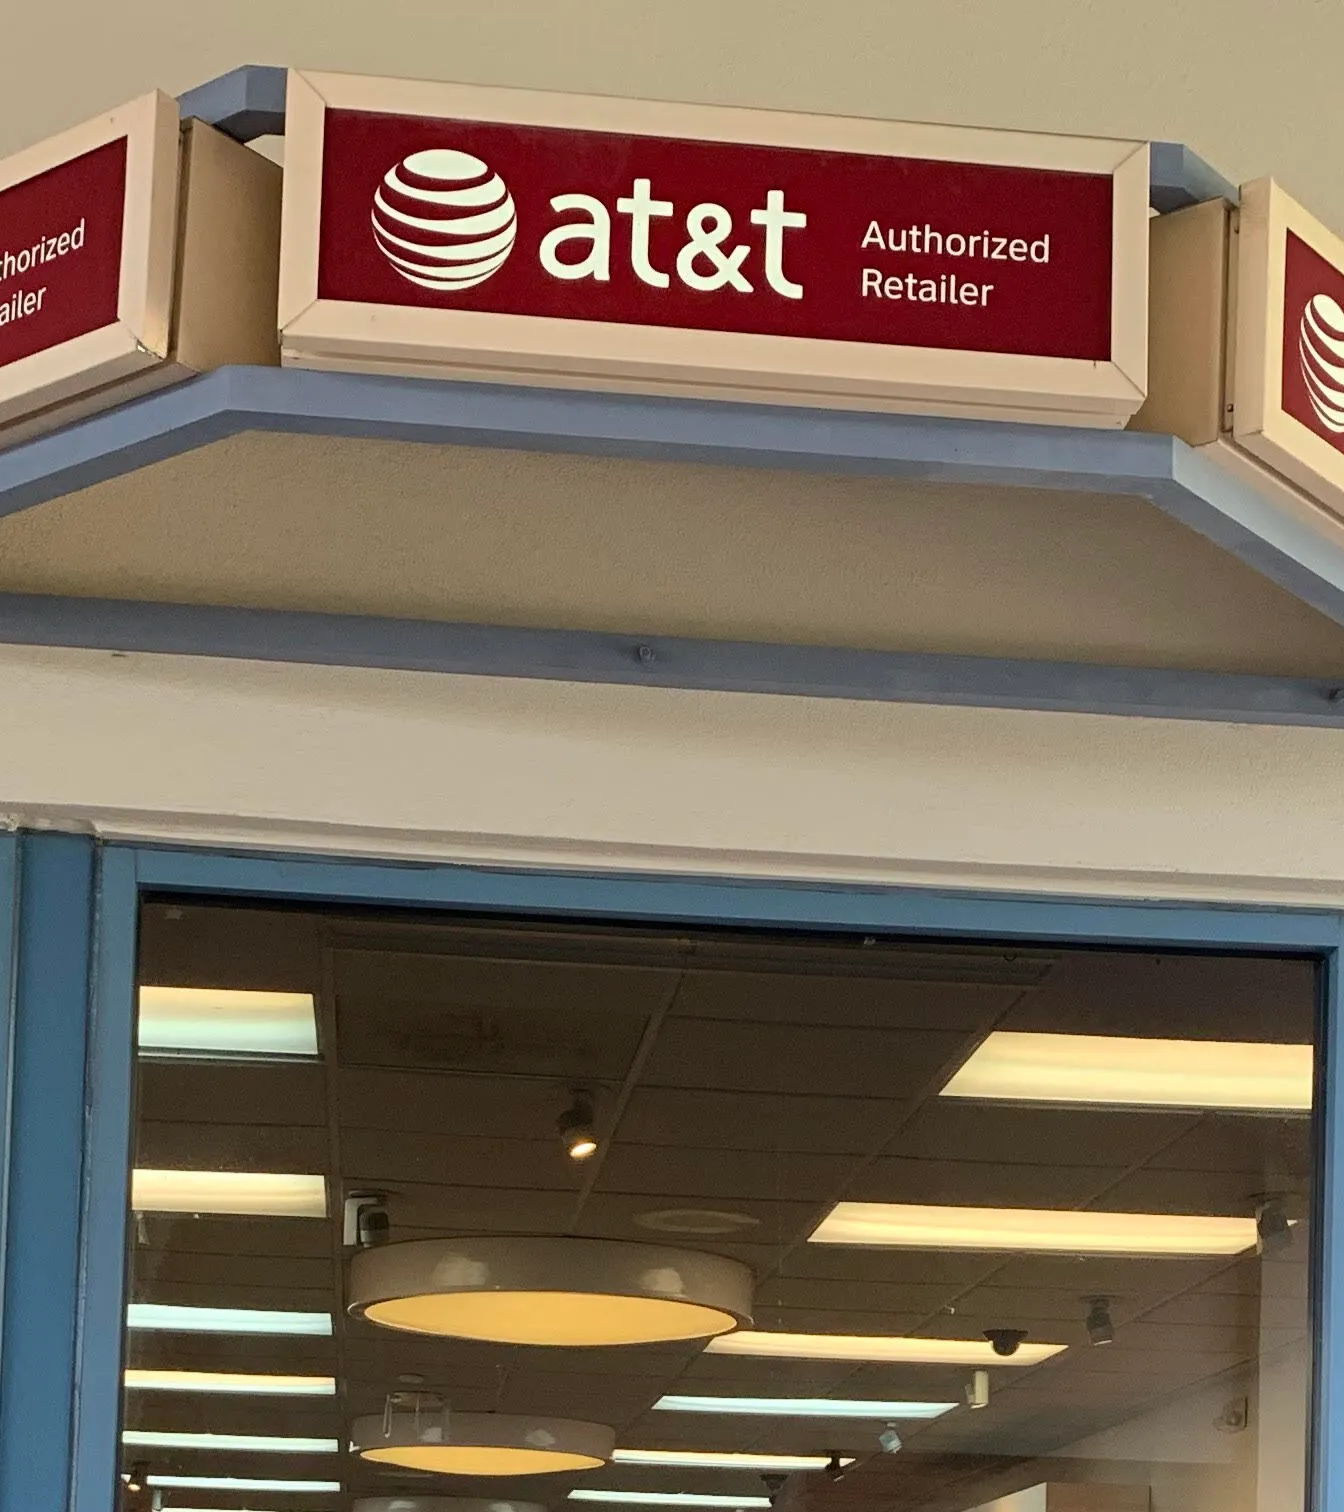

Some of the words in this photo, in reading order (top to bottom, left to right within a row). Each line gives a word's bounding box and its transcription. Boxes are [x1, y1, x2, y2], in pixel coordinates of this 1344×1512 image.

[538, 178, 807, 300] at&t
[861, 220, 1050, 264] Authorized
[861, 268, 994, 307] Retailer
